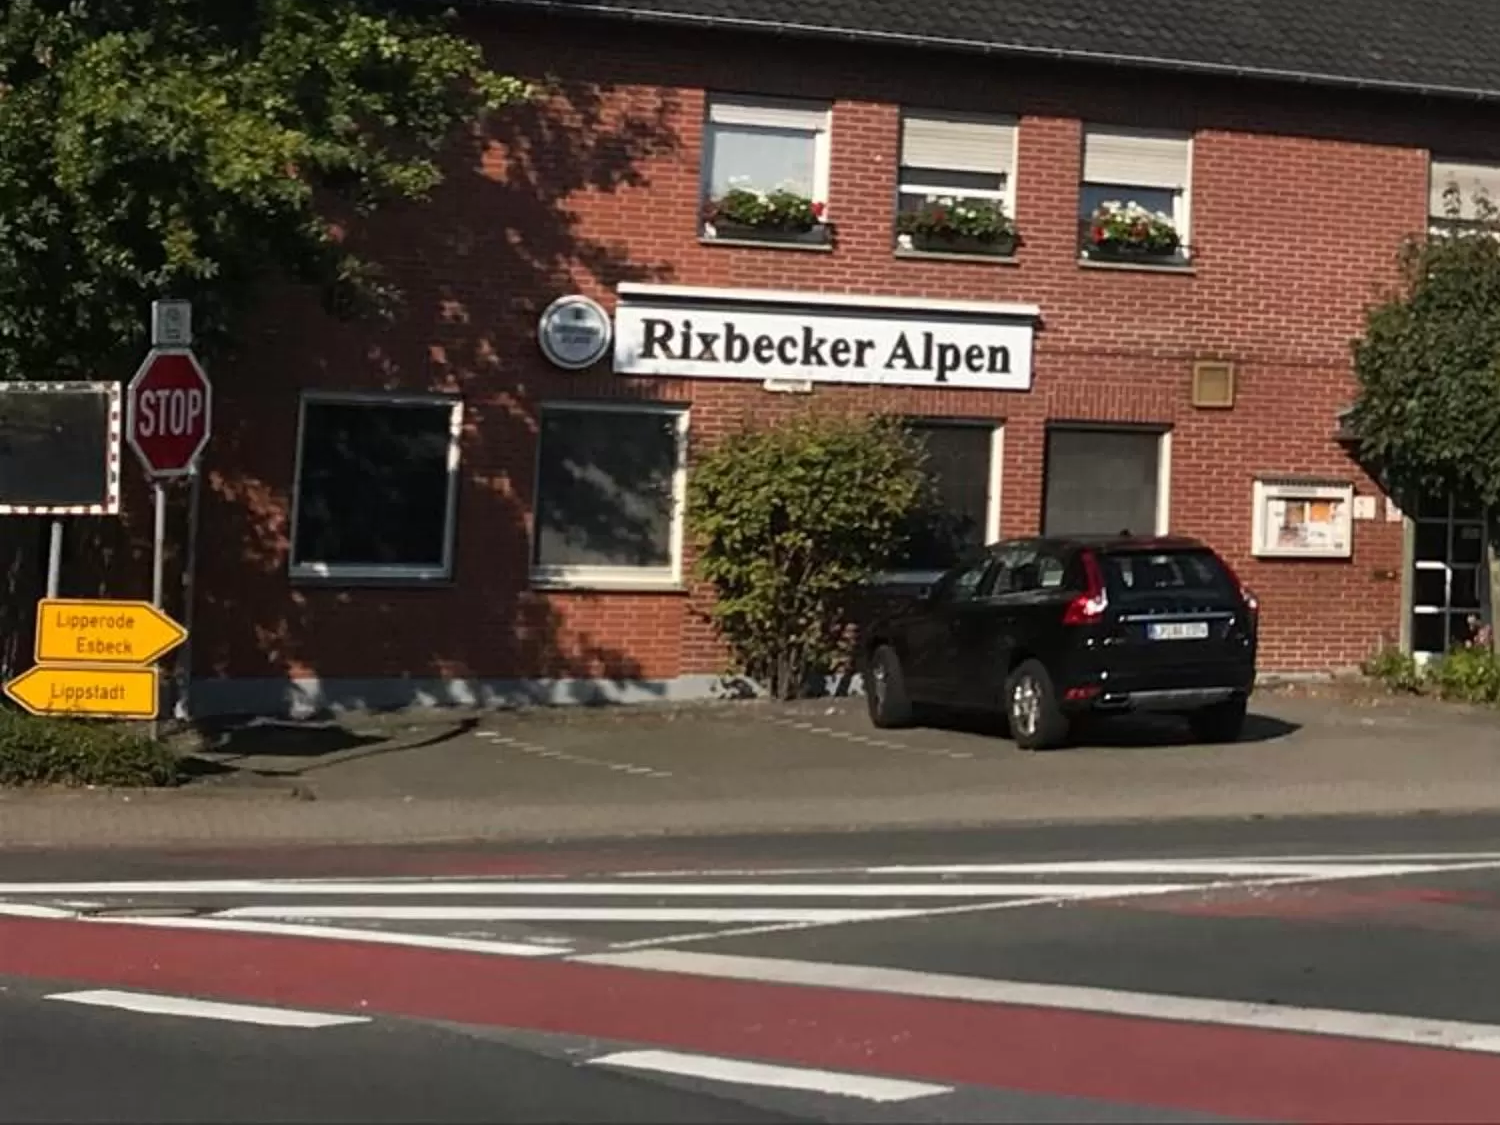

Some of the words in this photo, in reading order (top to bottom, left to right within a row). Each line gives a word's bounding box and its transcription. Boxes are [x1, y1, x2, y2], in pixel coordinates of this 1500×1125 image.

[639, 318, 875, 368] Rixbecker
[884, 330, 1012, 381] Alpen
[139, 388, 202, 437] STOP
[56, 611, 136, 631] Lipperode
[76, 636, 133, 654] Esbeck
[50, 682, 127, 703] Lippstadt
